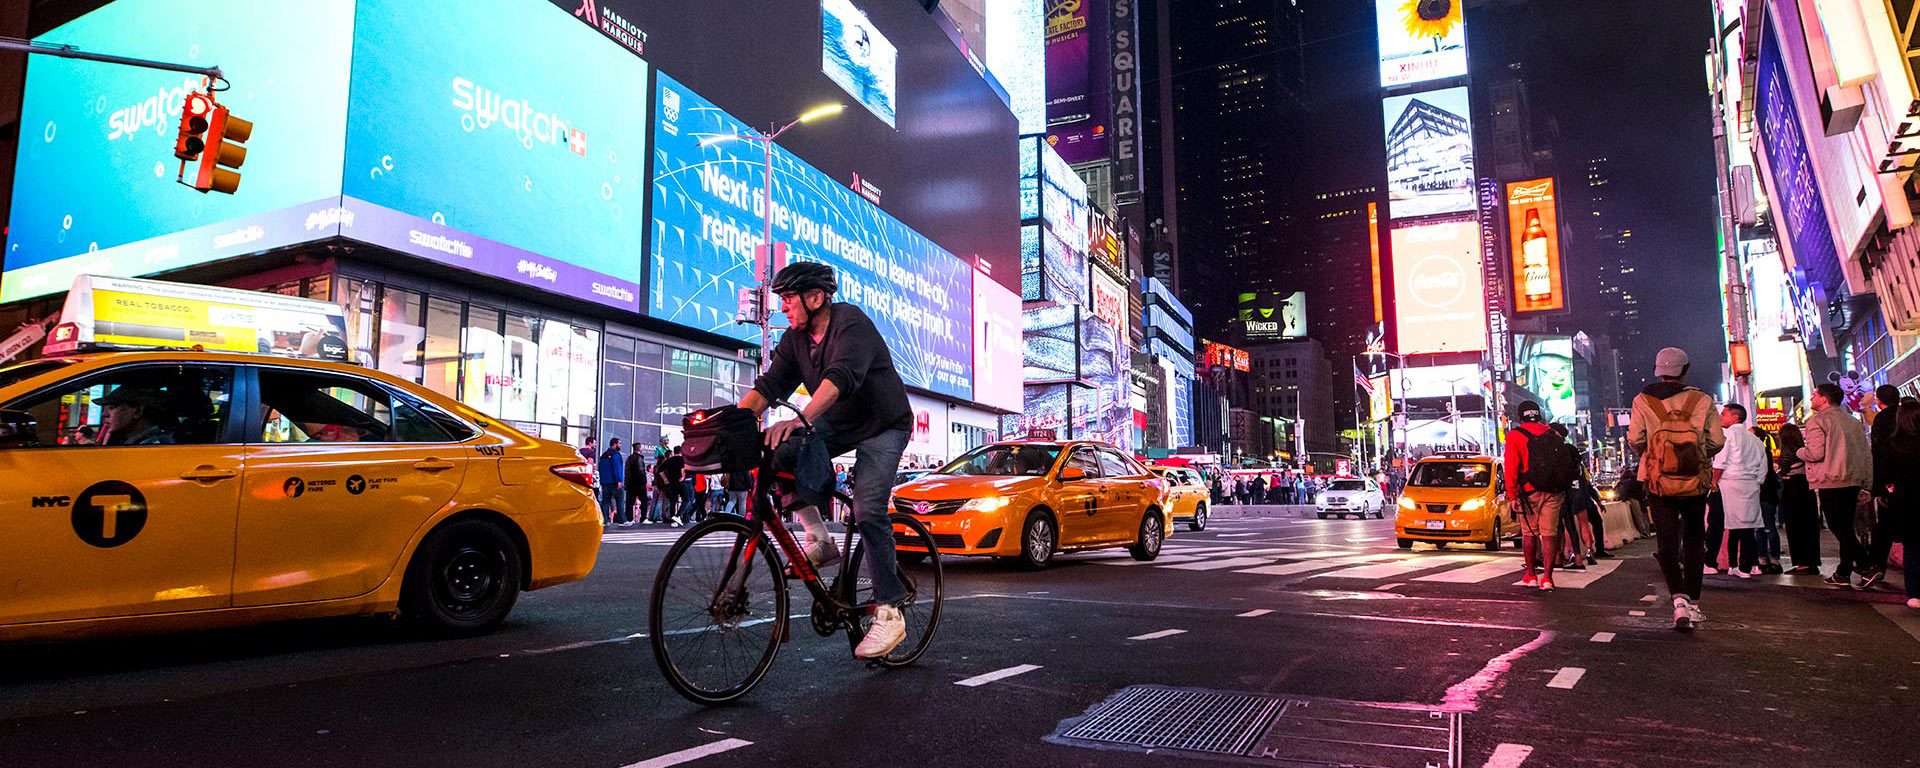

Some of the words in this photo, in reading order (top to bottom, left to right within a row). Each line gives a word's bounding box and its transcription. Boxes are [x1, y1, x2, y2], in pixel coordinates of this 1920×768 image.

[603, 6, 648, 43] MARRIOTT
[603, 20, 642, 52] MARQUIS
[452, 76, 569, 150] swatch
[1114, 30, 1134, 160] SQUARE
[703, 160, 749, 211] Next
[791, 211, 820, 245] you
[822, 224, 874, 273] threaten
[874, 252, 888, 278] to
[889, 257, 915, 293] leave
[916, 273, 932, 300] the
[1087, 205, 1106, 245] ATS
[116, 299, 142, 308] REAL
[841, 271, 863, 302] the
[863, 284, 891, 314] most
[892, 295, 922, 329] places
[922, 307, 944, 340] from
[32, 496, 71, 508] NYC
[90, 494, 131, 539] T
